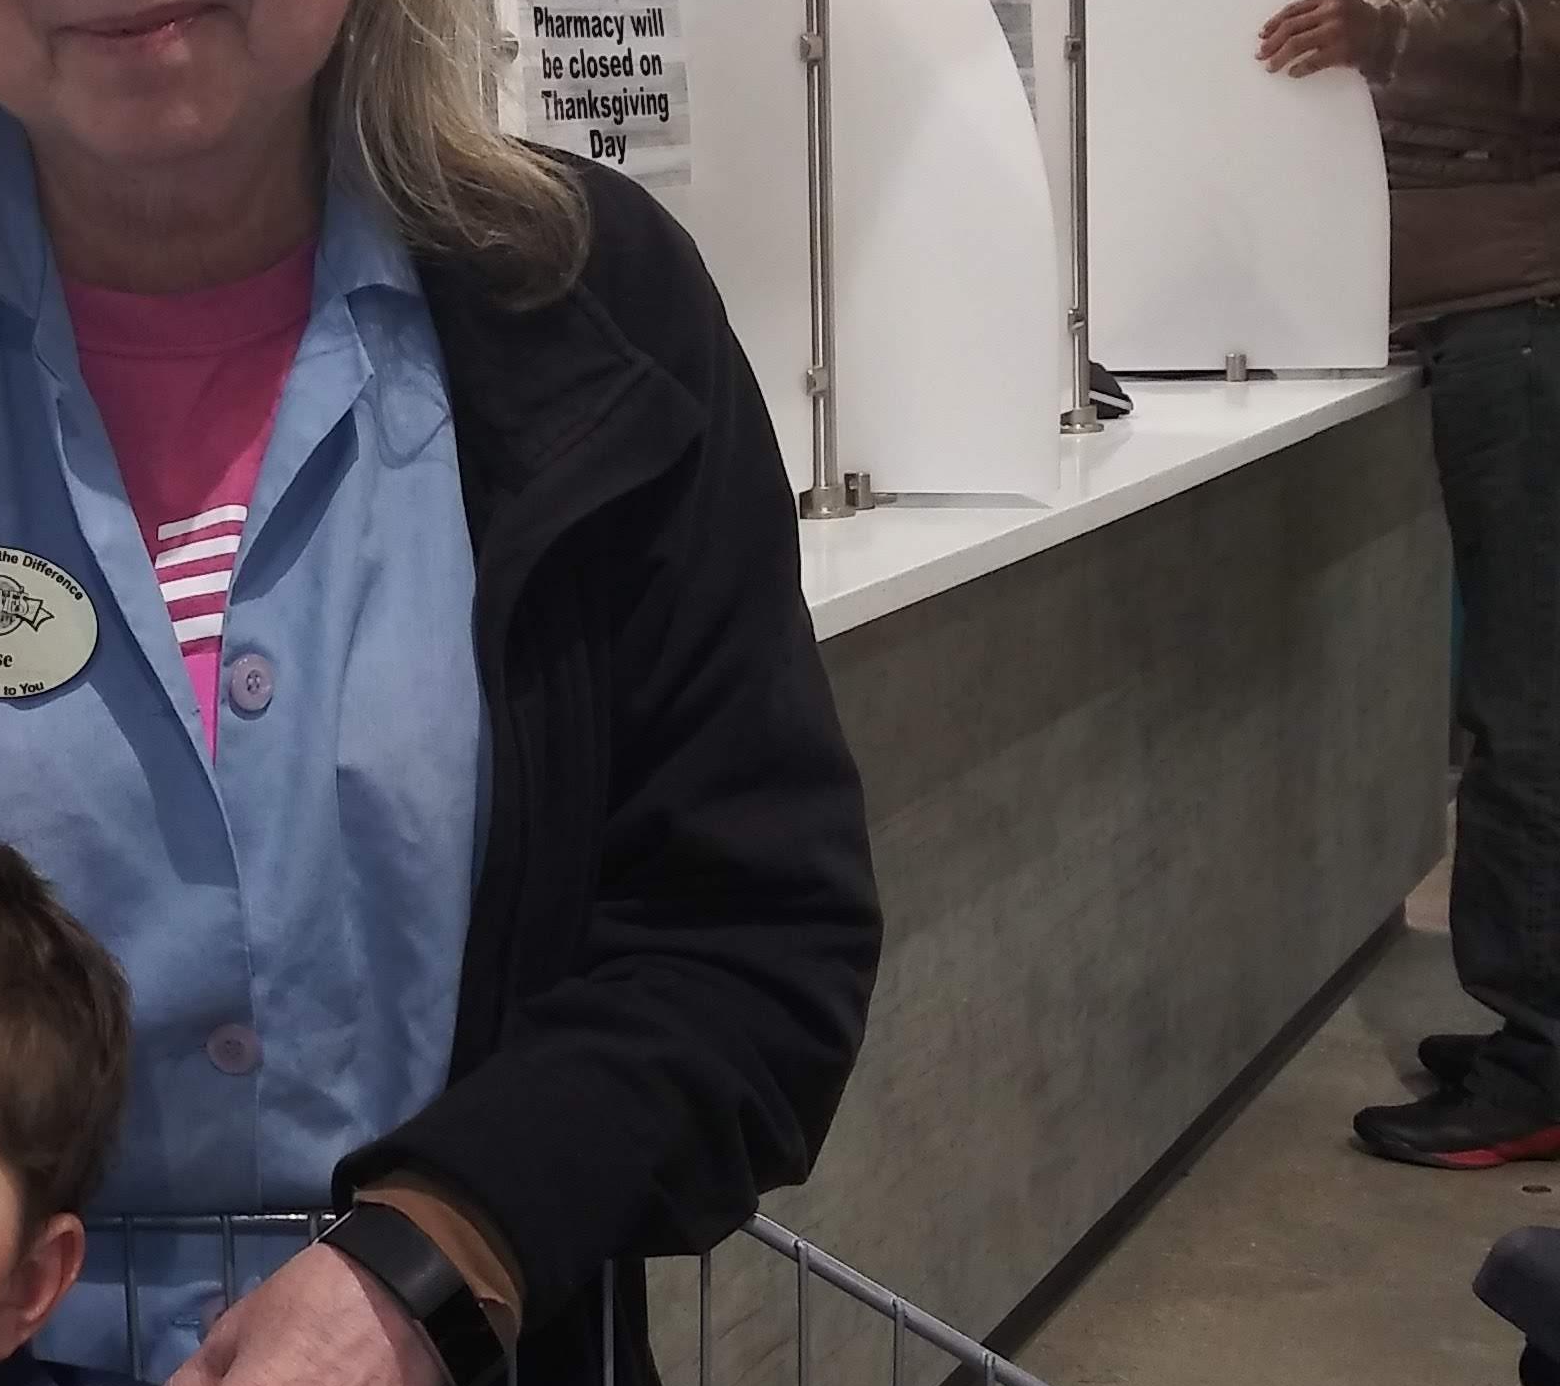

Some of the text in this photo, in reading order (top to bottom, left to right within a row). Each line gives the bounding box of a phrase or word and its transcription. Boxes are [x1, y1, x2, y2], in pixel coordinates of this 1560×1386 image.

[533, 6, 665, 45] Pharmacy will
[542, 47, 662, 80] be closed on
[541, 86, 669, 126] Thanksgiving
[590, 129, 627, 165] Day
[22, 554, 84, 601] Difference
[4, 685, 17, 696] to
[19, 682, 44, 695] You
